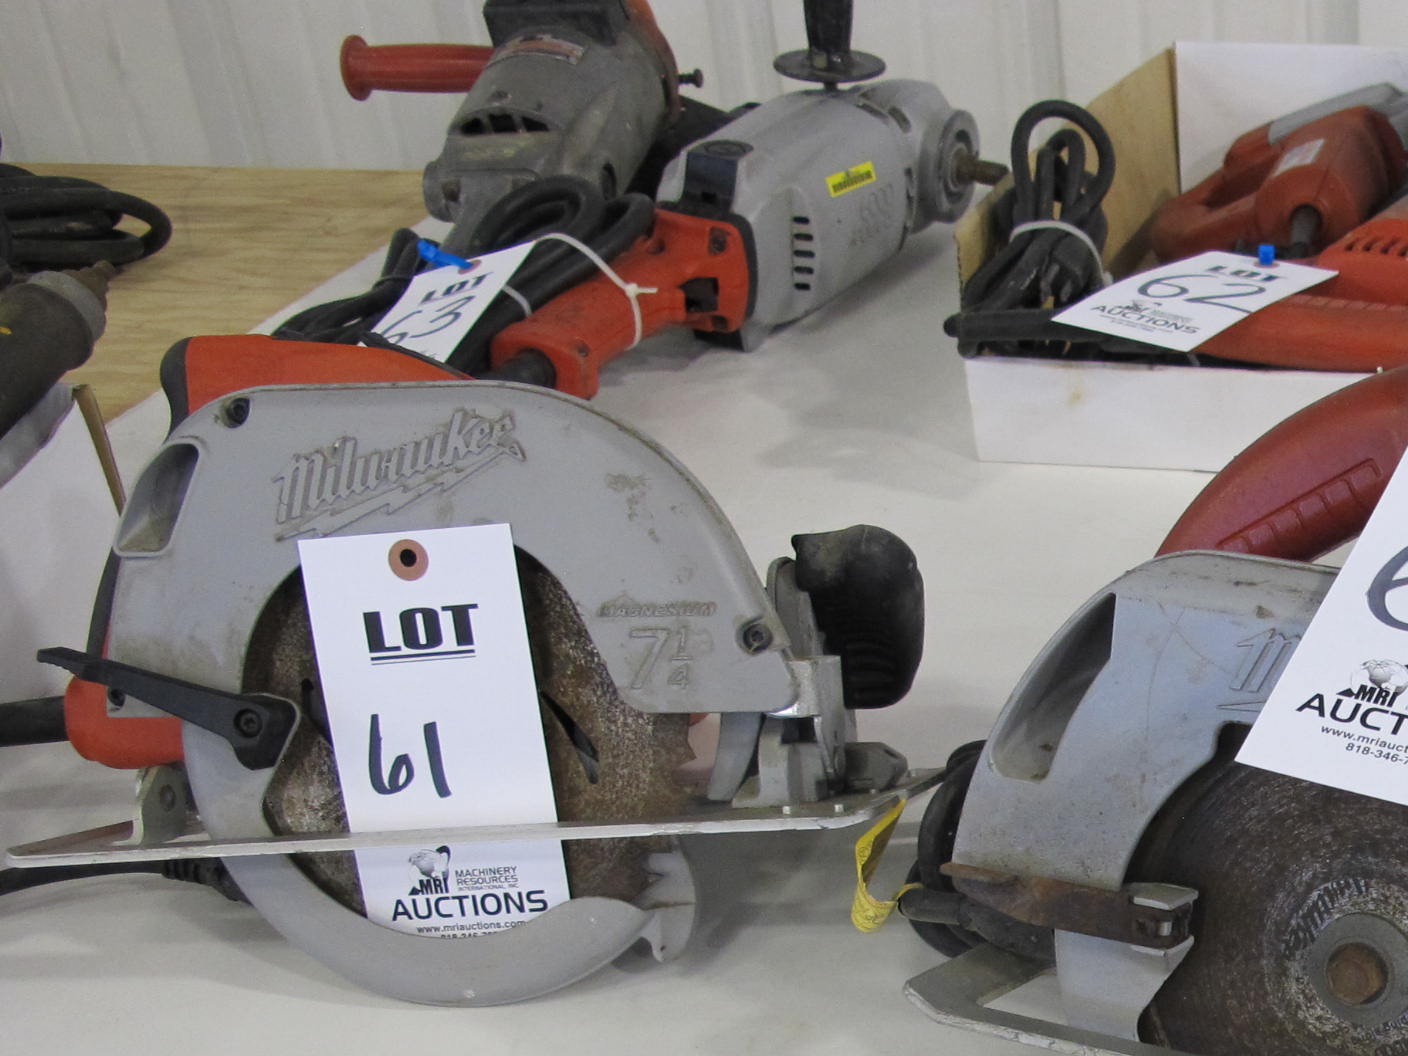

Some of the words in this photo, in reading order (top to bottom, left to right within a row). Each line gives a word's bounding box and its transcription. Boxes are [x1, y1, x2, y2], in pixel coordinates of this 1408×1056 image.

[1205, 265, 1286, 282] LOT
[1137, 274, 1266, 314] 62
[1090, 305, 1200, 334] AUCTIONS
[272, 408, 527, 525] Milwaukee
[362, 603, 479, 654] LOT
[1355, 684, 1399, 708] MRI
[368, 713, 453, 799] 61
[418, 877, 451, 897] MRI
[455, 866, 518, 879] MACHINERY
[456, 875, 519, 886] RESOURCES
[391, 889, 549, 923] AUCTIONS
